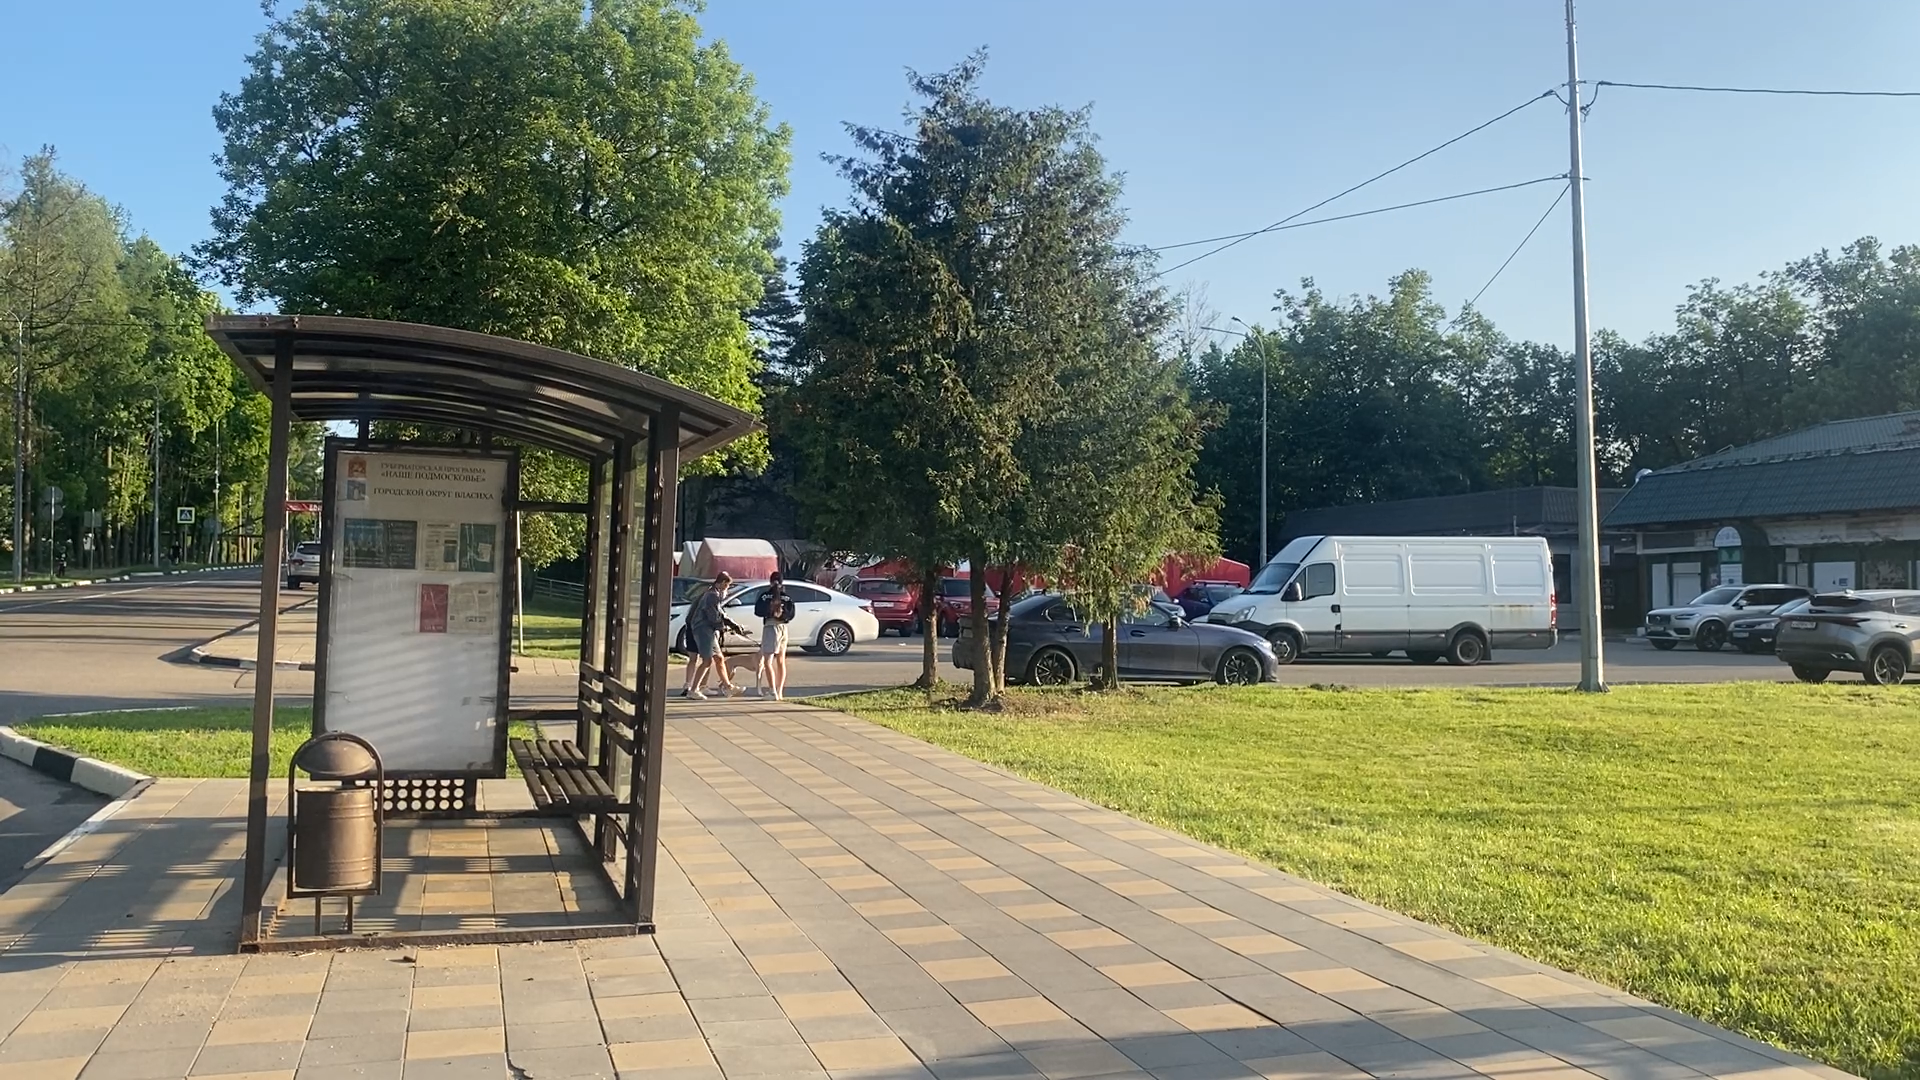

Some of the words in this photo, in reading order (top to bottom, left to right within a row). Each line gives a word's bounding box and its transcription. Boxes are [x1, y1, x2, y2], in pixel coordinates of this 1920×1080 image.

[381, 462, 443, 472] ГУБЕРНАТОРСКАЯ
[444, 465, 486, 474] ПРОГРАММА
[381, 471, 414, 479] «НАШЕ
[415, 471, 486, 483] ПОДМОСКОВЬЕ»
[374, 487, 424, 497] ГОРОДСКОЙ
[426, 489, 451, 498] ОКРУГ
[454, 491, 494, 500] ВЛАСИХА
